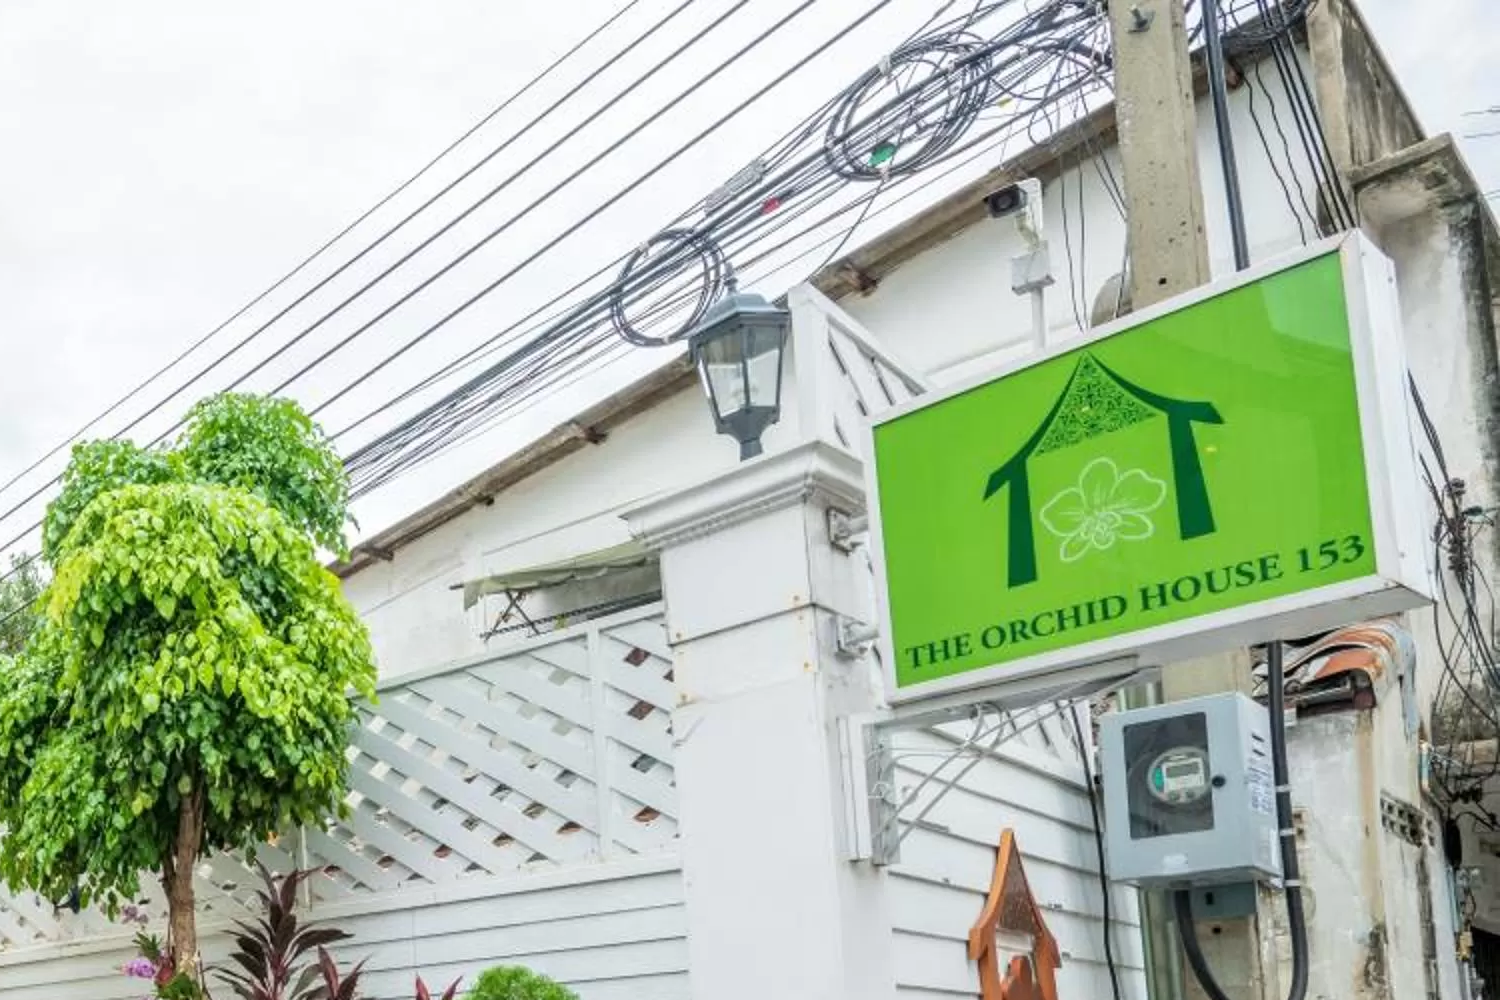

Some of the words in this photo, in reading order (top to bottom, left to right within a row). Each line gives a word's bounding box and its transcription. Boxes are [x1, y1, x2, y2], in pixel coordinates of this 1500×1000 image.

[905, 633, 973, 669] THE
[981, 595, 1128, 649] ORCHID
[1139, 553, 1284, 611] HOUSE
[1297, 534, 1365, 573] 153
